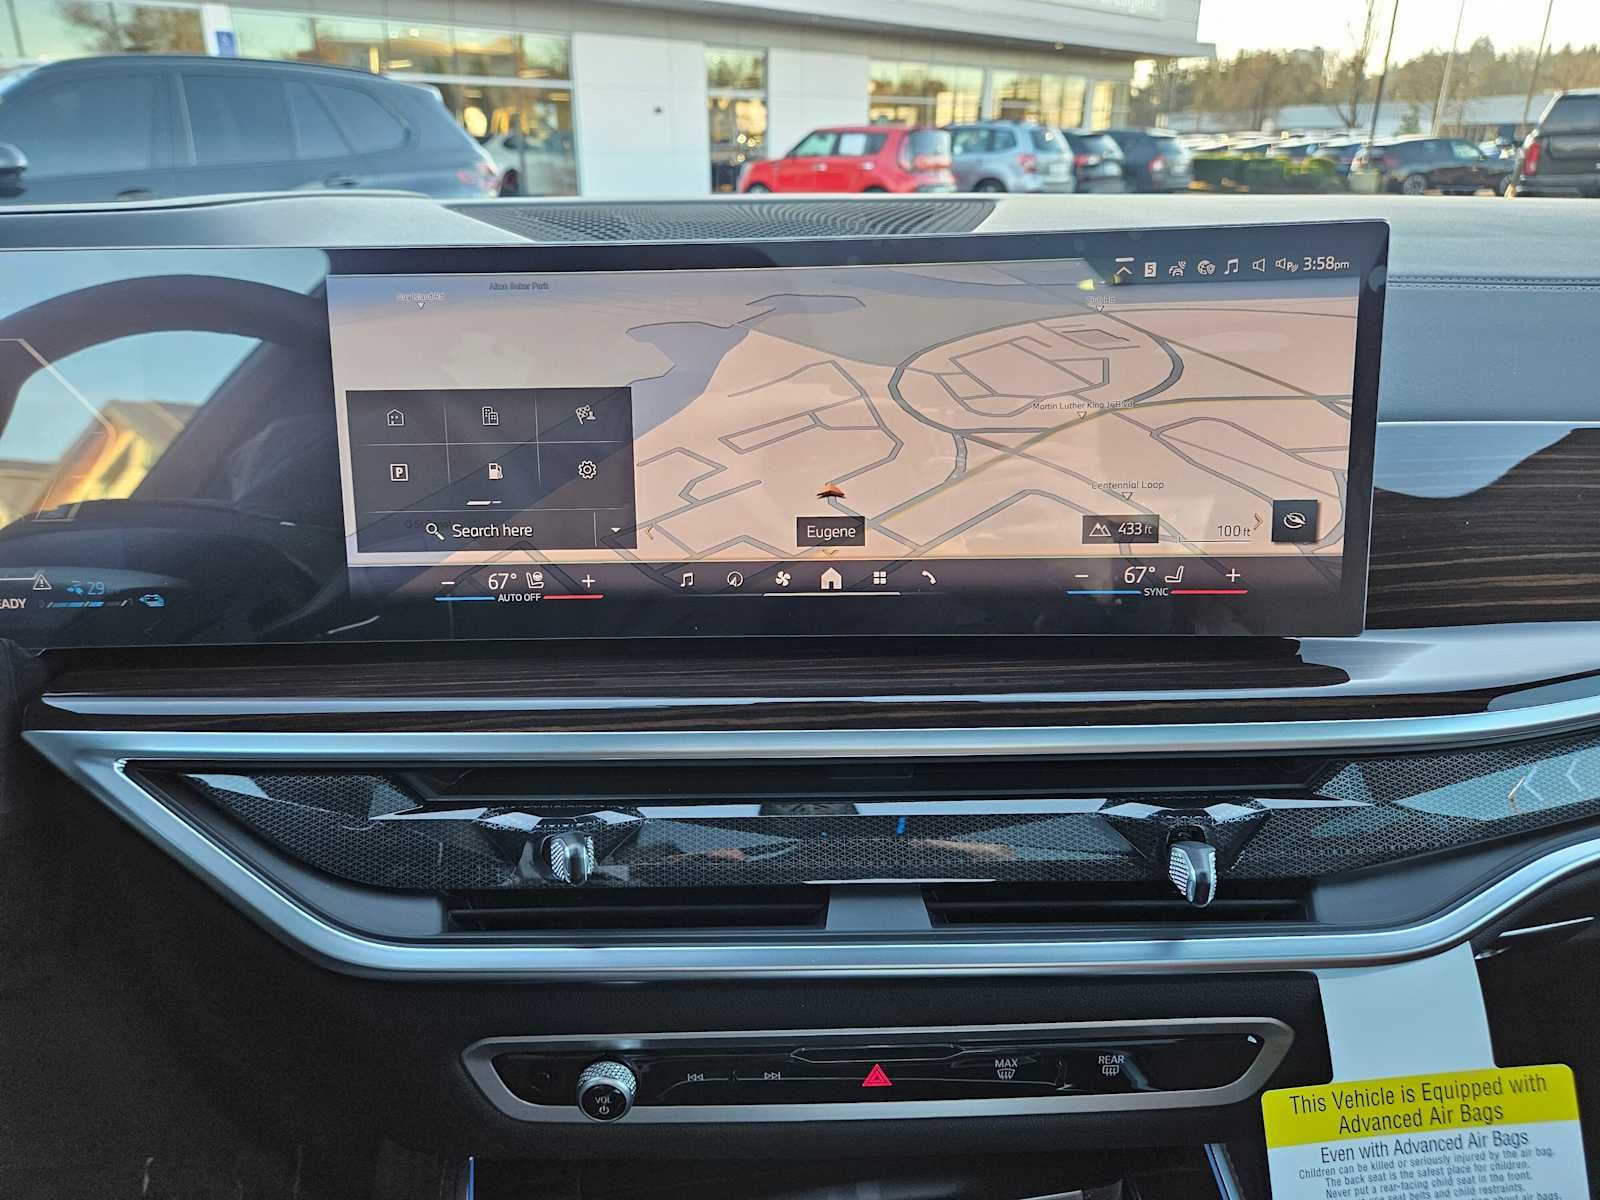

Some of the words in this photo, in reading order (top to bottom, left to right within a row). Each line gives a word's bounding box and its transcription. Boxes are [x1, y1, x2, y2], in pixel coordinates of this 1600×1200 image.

[1302, 256, 1350, 272] 3:58pm
[1032, 401, 1058, 410] Martin
[1059, 401, 1085, 410] Luther
[1087, 400, 1104, 411] King
[1091, 481, 1139, 490] Centennial
[1141, 481, 1165, 490] Loop
[452, 523, 499, 538] Search
[502, 523, 533, 537] here
[806, 525, 856, 541] Eugene
[1118, 522, 1142, 535] 433
[1144, 524, 1152, 535] ft
[1217, 525, 1241, 537] 100
[1242, 527, 1251, 537] ft
[87, 582, 104, 595] 29
[1144, 587, 1168, 597] SYNC
[498, 592, 521, 602] AUTO
[523, 592, 541, 602] OFF
[995, 1058, 1018, 1068] MAX
[1098, 1055, 1124, 1064] REAR
[594, 1096, 611, 1104] VOL
[1289, 1094, 1327, 1115] This
[1332, 1087, 1395, 1110] Vehicle
[1400, 1085, 1416, 1103] is
[1421, 1076, 1503, 1103] Equipped
[1508, 1073, 1547, 1095] with
[1339, 1108, 1423, 1135] Advanced
[1430, 1106, 1453, 1126] Air
[1460, 1103, 1504, 1125] Bags
[1321, 1147, 1355, 1164] Even
[1359, 1141, 1389, 1160] with
[1394, 1134, 1463, 1156] Advanced
[1468, 1132, 1488, 1149] Air
[1492, 1130, 1529, 1149] Bags
[1299, 1167, 1336, 1180] Children
[1339, 1166, 1355, 1175] can
[1357, 1163, 1368, 1173] be
[1371, 1160, 1394, 1170] killed
[1398, 1159, 1407, 1167] or
[1410, 1154, 1450, 1168] seriously
[1454, 1150, 1486, 1164] injured
[1489, 1150, 1500, 1161] by
[1502, 1149, 1518, 1159] the
[1521, 1148, 1532, 1158] air
[1326, 1177, 1341, 1188] The
[1344, 1174, 1365, 1186] back
[1368, 1172, 1387, 1183] seat
[1389, 1171, 1398, 1180] is
[1400, 1168, 1414, 1179] the
[1417, 1164, 1444, 1178] safest
[1447, 1163, 1471, 1176] place
[1473, 1161, 1487, 1172] for
[1489, 1159, 1530, 1172] children.
[1326, 1188, 1351, 1200] Never
[1354, 1185, 1369, 1197] put
[1380, 1179, 1429, 1193] rear-facing
[1431, 1177, 1454, 1188] child
[1456, 1174, 1475, 1186] seat
[1478, 1173, 1487, 1183] in
[1489, 1172, 1504, 1182] the
[1434, 1187, 1451, 1198] and
[1453, 1184, 1475, 1197] child
